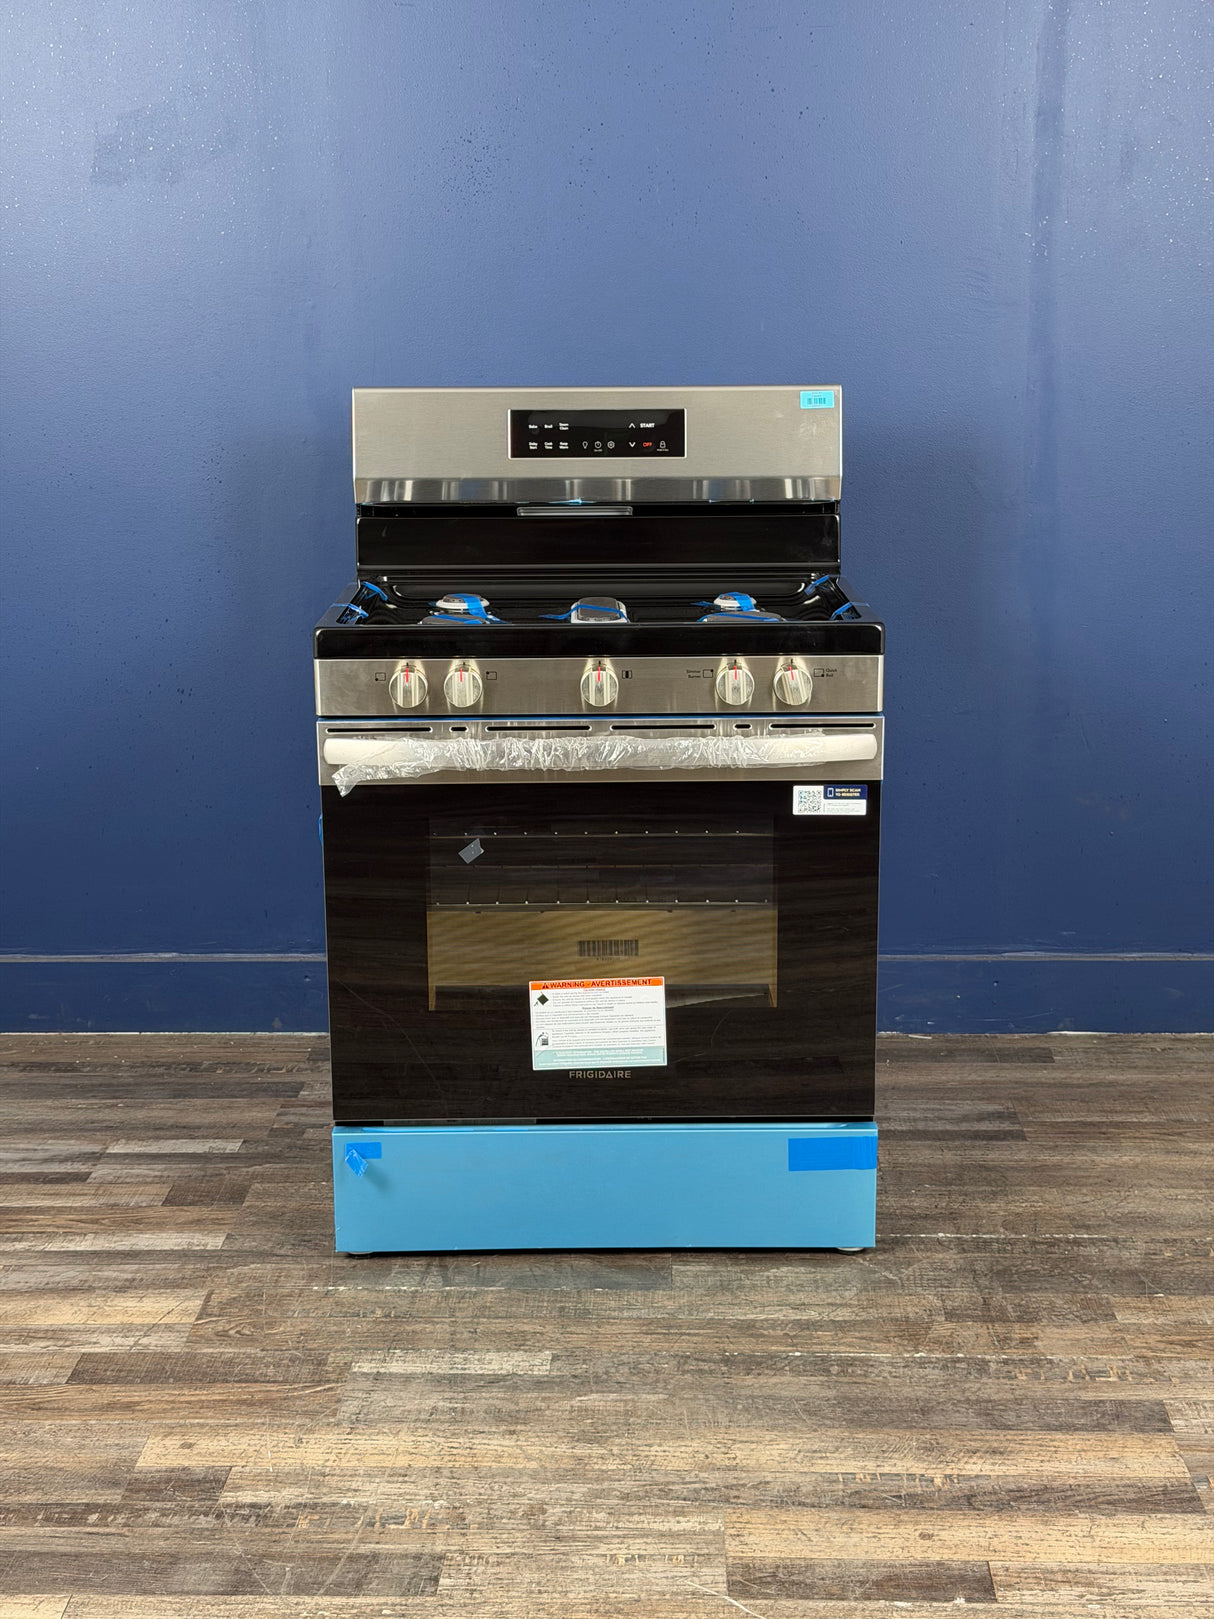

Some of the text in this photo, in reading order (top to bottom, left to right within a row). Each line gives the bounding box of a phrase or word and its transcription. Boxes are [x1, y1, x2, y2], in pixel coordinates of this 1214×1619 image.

[549, 981, 585, 989] WARNING
[590, 978, 652, 988] AVERTISSEMENT
[568, 1070, 631, 1079] FRIGIDAIRE
